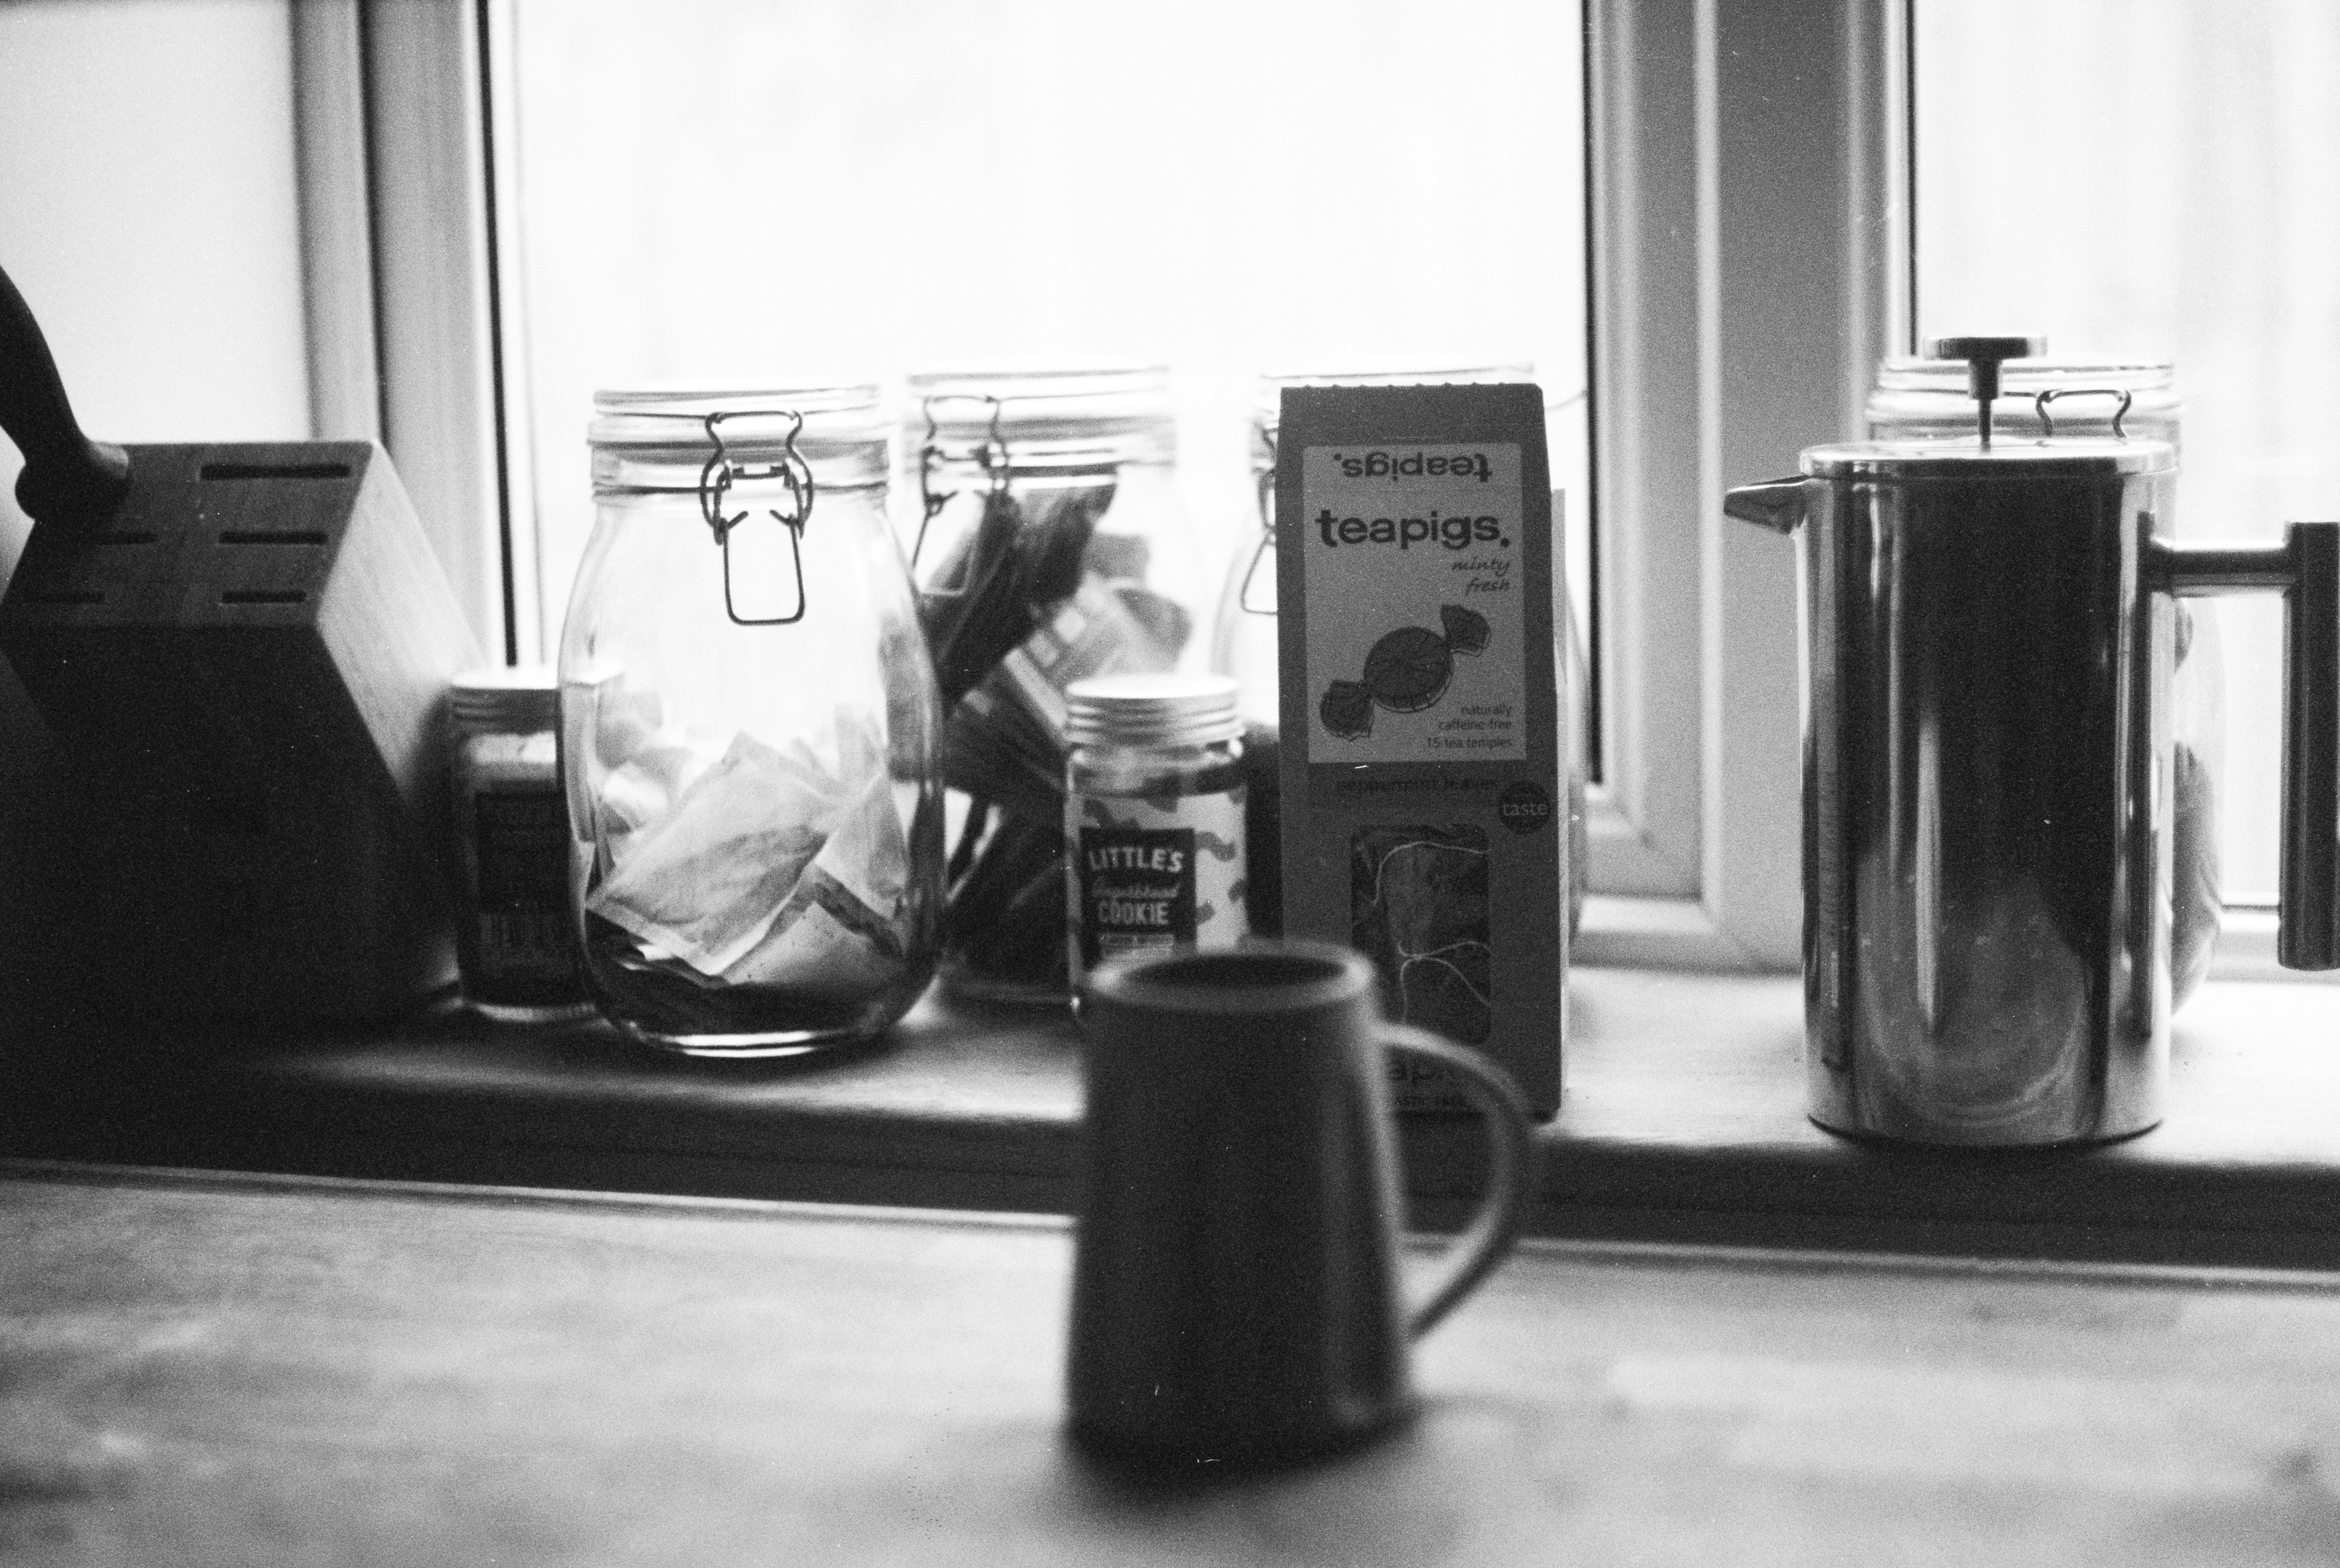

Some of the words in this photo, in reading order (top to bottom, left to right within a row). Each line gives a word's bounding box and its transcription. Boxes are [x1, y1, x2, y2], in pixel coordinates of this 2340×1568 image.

[1332, 452, 1493, 482] teapigs.
[1315, 509, 1510, 551] teapigs.
[1452, 556, 1511, 577] minty
[1465, 577, 1510, 596] fresh
[1461, 704, 1512, 717] naturally
[1427, 737, 1441, 748] 15
[1445, 737, 1463, 748] tea
[1467, 737, 1512, 750] temples
[1502, 802, 1549, 816] taste
[1098, 900, 1169, 925] COOKIE
